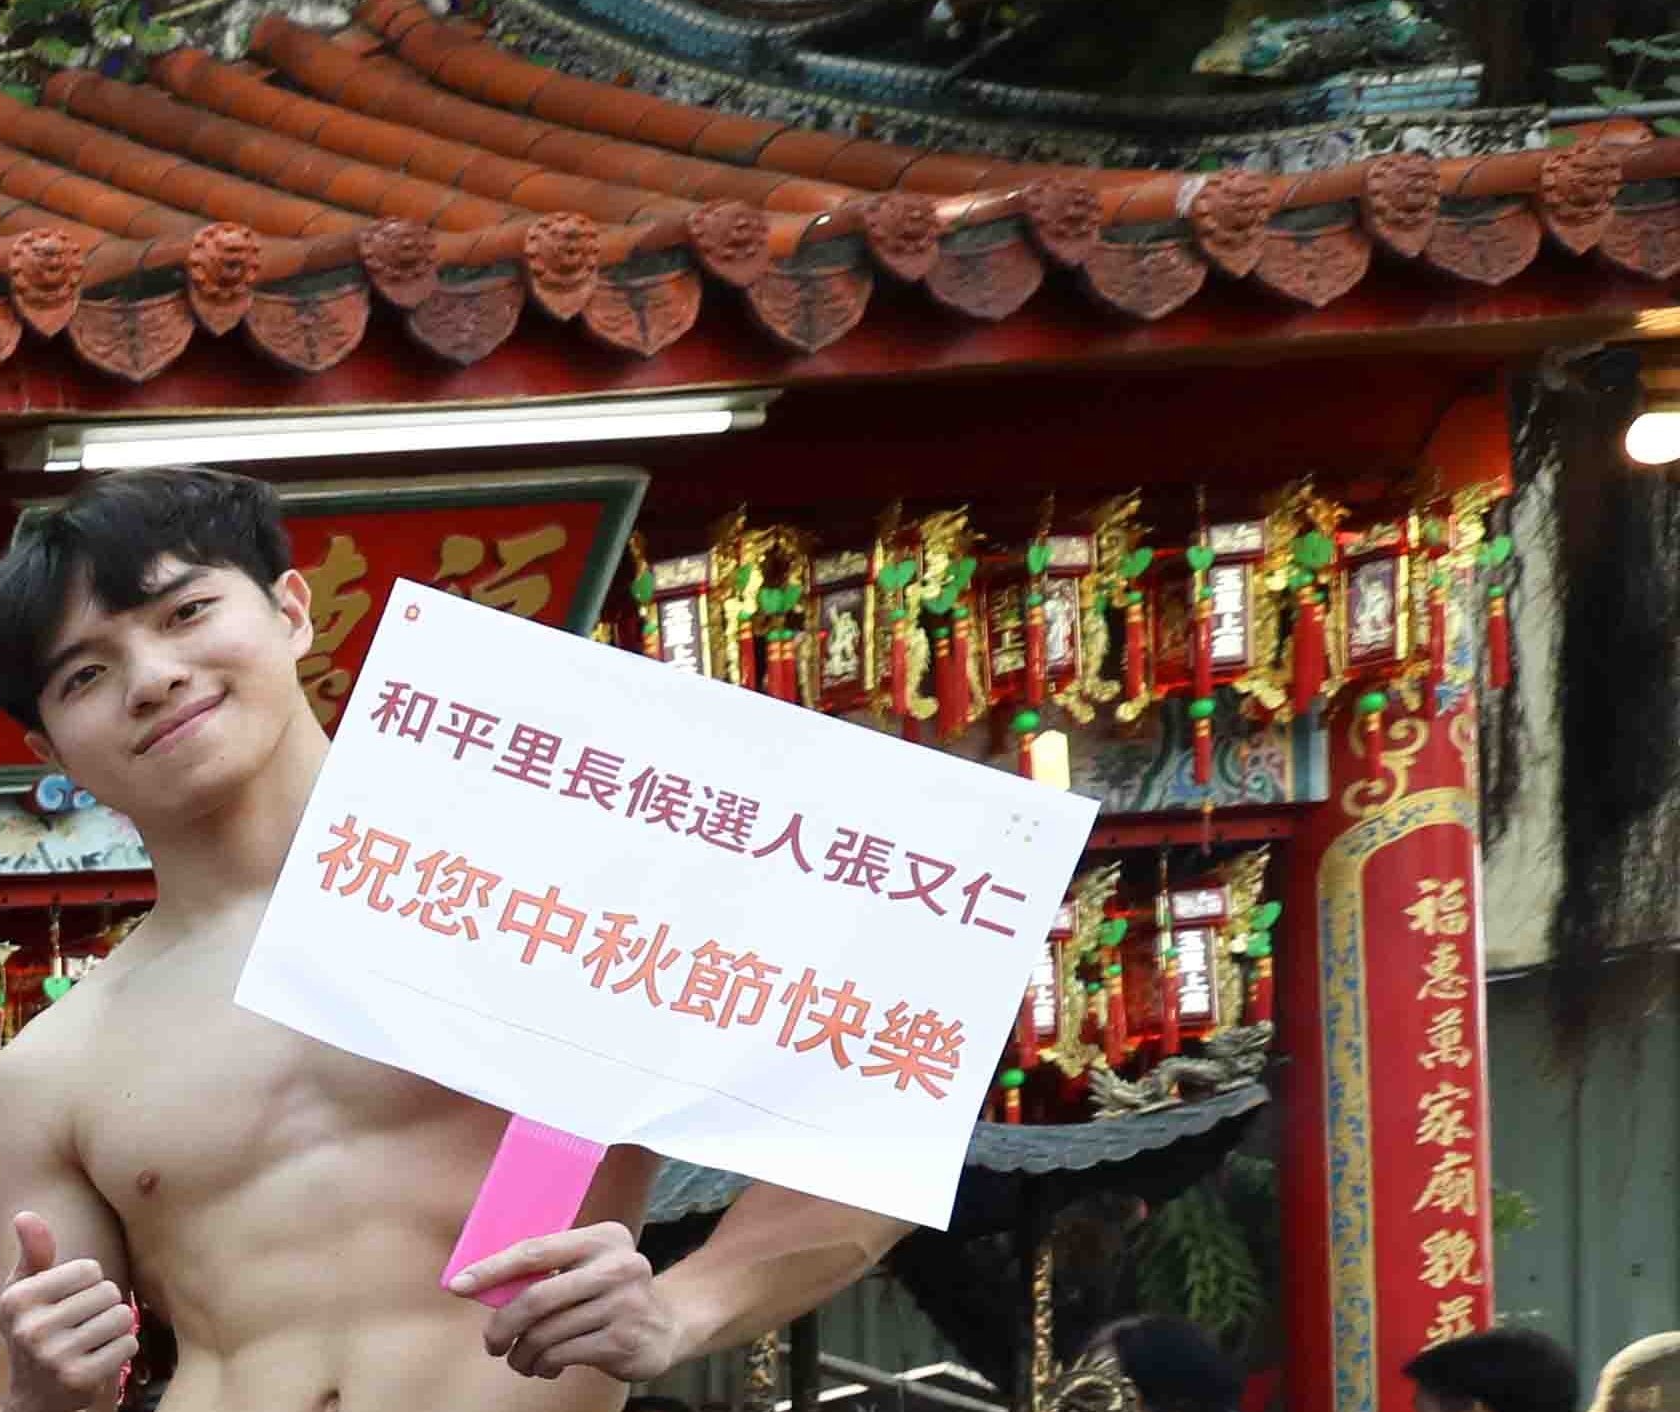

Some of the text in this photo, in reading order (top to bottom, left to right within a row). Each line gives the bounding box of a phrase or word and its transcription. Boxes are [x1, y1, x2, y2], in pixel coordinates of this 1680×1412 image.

[368, 679, 1027, 938] 和平里長候選人張又仁
[317, 814, 966, 1100] 祝您中秋節快樂
